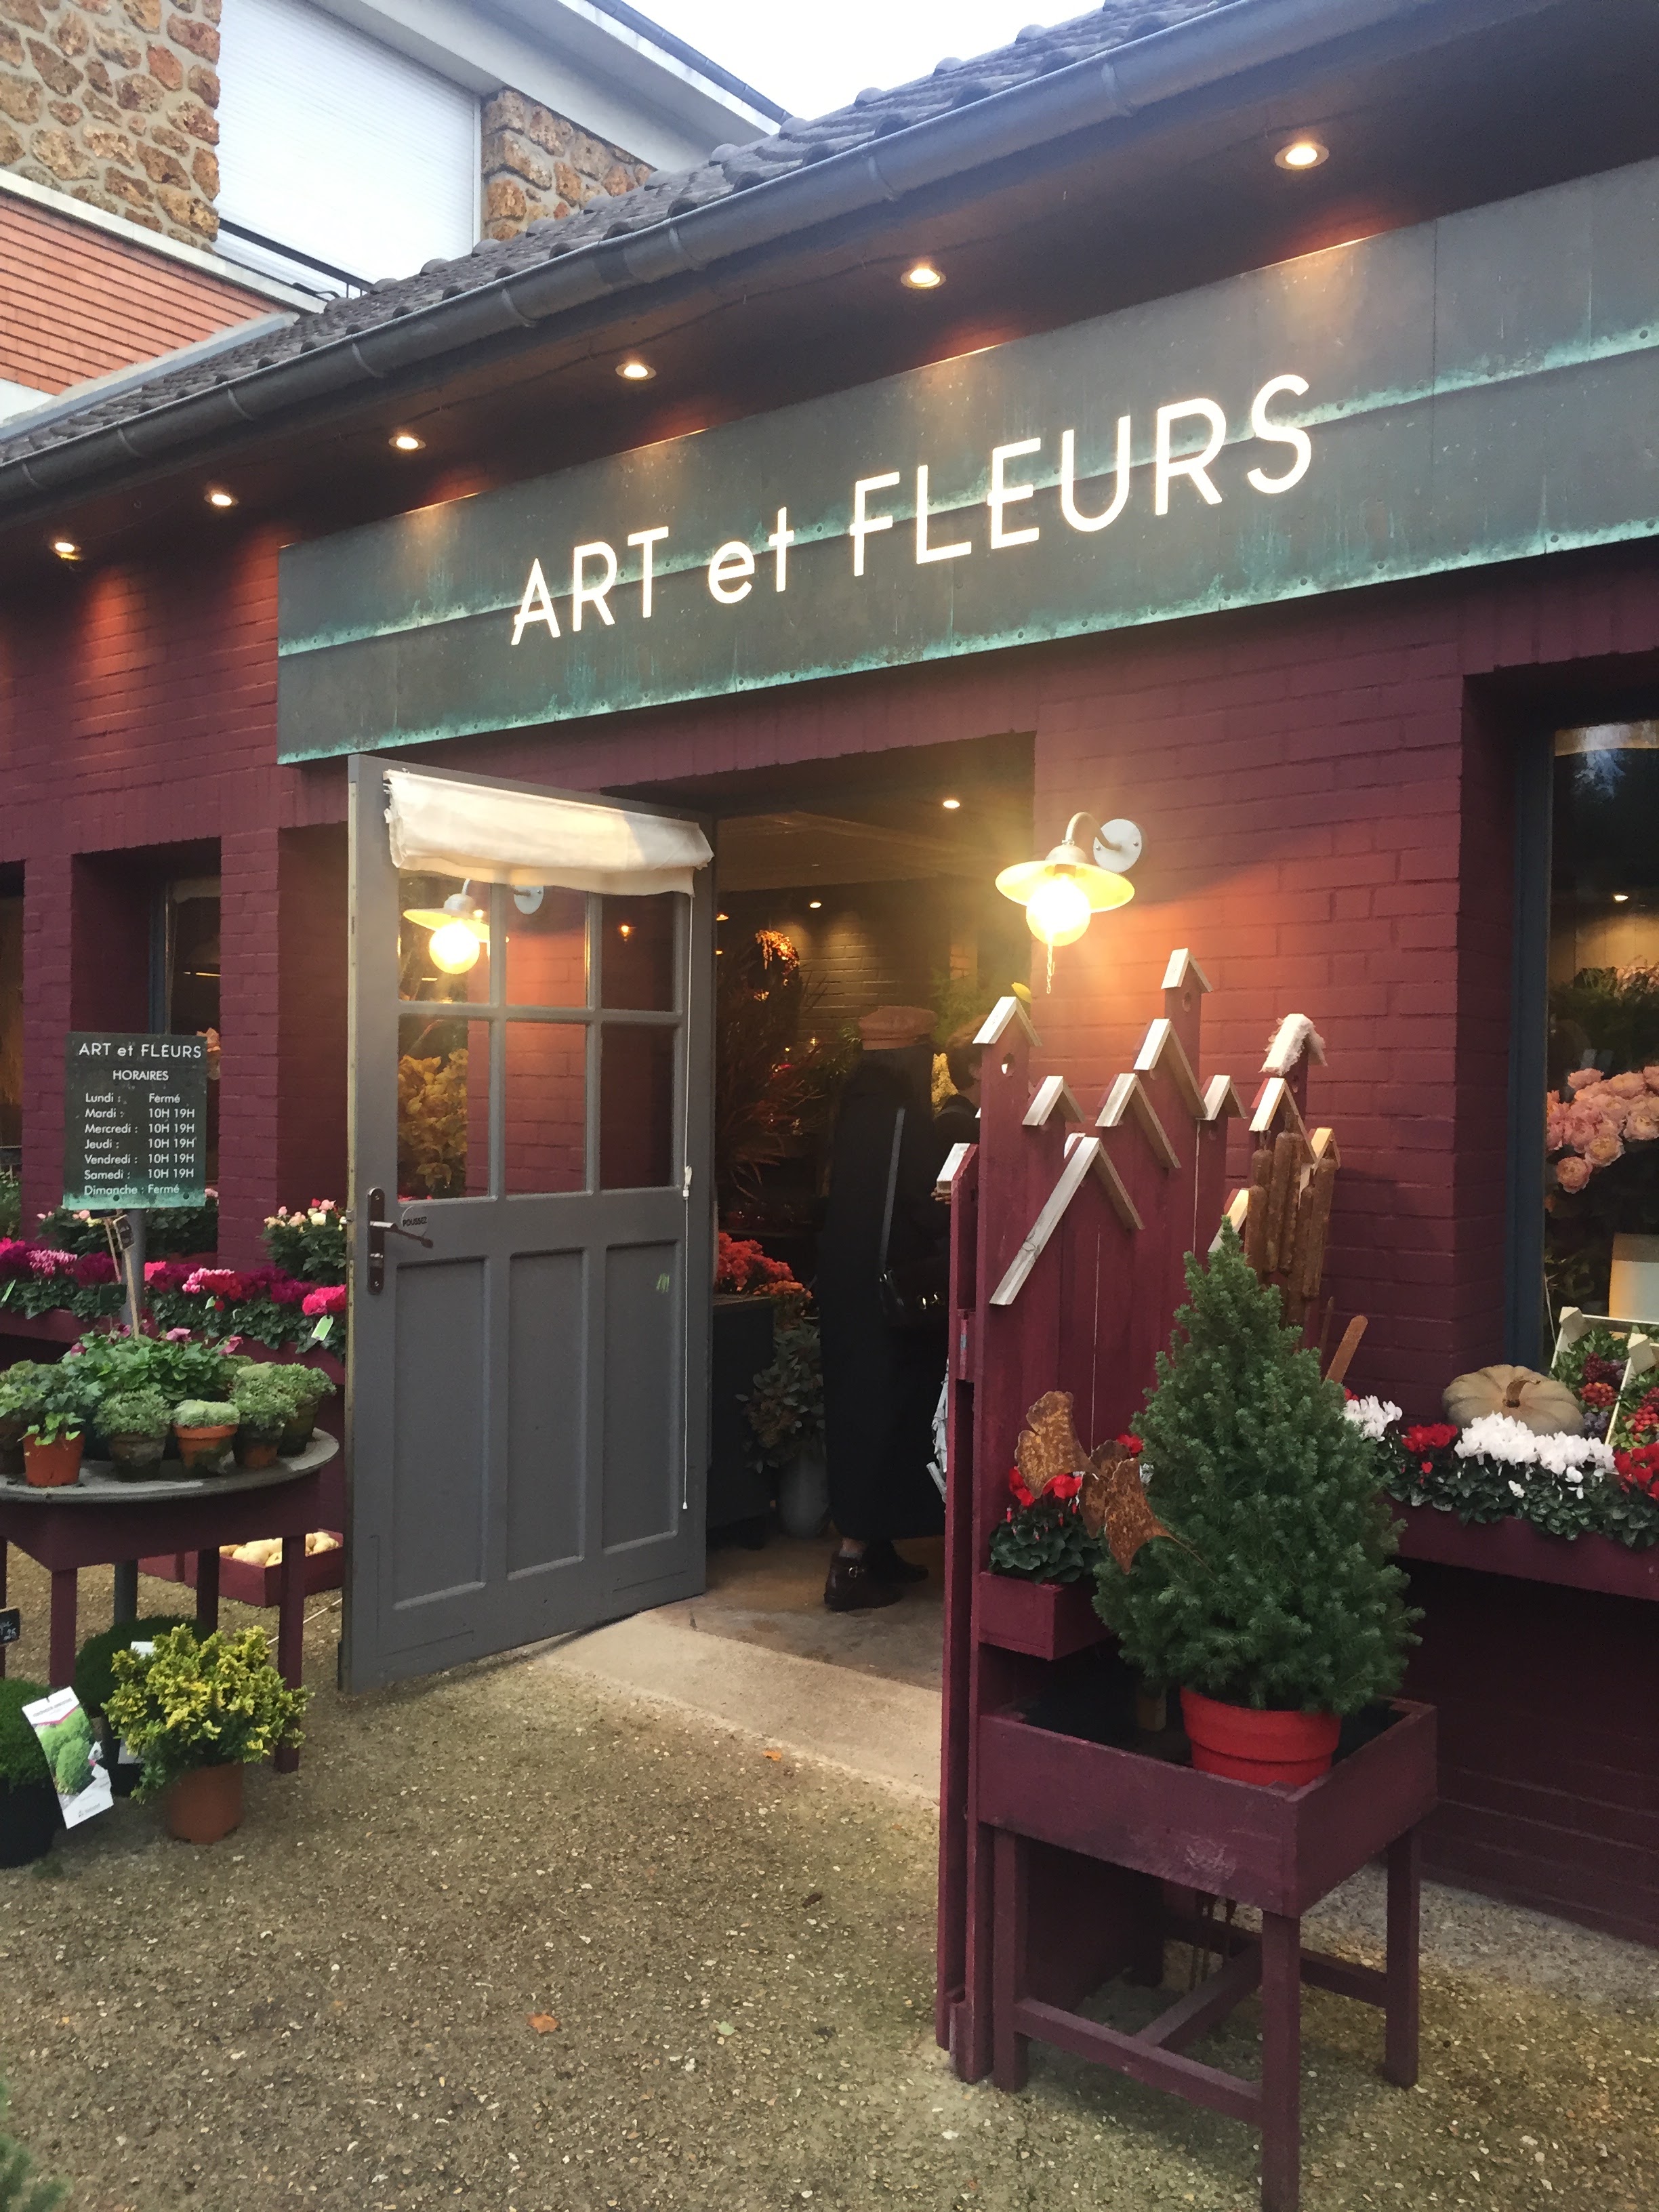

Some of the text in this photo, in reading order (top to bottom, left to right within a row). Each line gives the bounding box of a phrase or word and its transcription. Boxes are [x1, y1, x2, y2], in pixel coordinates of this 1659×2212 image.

[512, 374, 1319, 646] ART et FLEURS
[79, 1042, 202, 1059] ART et FLEURS
[112, 1069, 169, 1081] HORAIRES
[85, 1092, 114, 1103] Lundi
[148, 1092, 180, 1103] Fermé
[85, 1108, 117, 1118] Mardi
[148, 1108, 169, 1118] 10H
[174, 1108, 195, 1118] 19H
[84, 1123, 131, 1134] Mercredi
[148, 1123, 169, 1133] 10H
[174, 1123, 195, 1133] 19H
[84, 1139, 112, 1149] Jeudi
[148, 1139, 169, 1149] 10H
[173, 1139, 194, 1149] 19H
[84, 1153, 131, 1164] Vendredi
[148, 1153, 169, 1164] 10H
[173, 1153, 194, 1164] 19H
[84, 1169, 123, 1180] Samedi
[148, 1168, 169, 1179] 10H
[173, 1168, 194, 1179] 19H
[84, 1185, 138, 1195] Dimanche
[148, 1184, 180, 1194] Fermé
